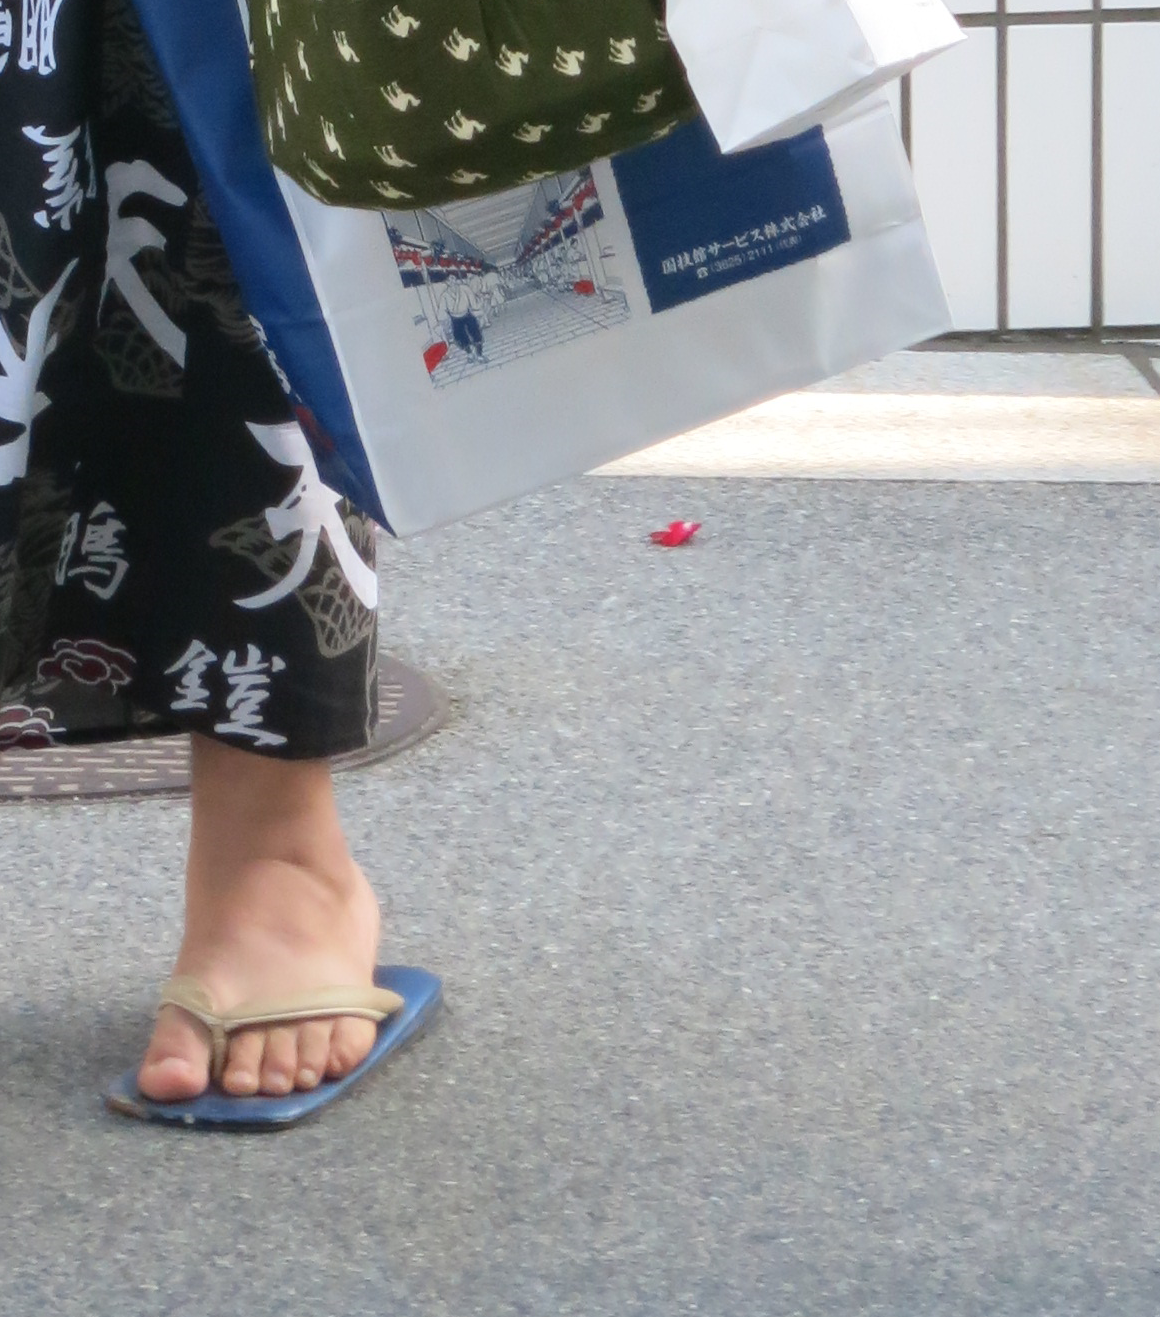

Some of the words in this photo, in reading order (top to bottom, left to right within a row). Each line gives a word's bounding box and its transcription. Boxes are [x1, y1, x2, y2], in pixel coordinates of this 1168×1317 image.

[661, 204, 827, 275] 国技館サービス株式会社
